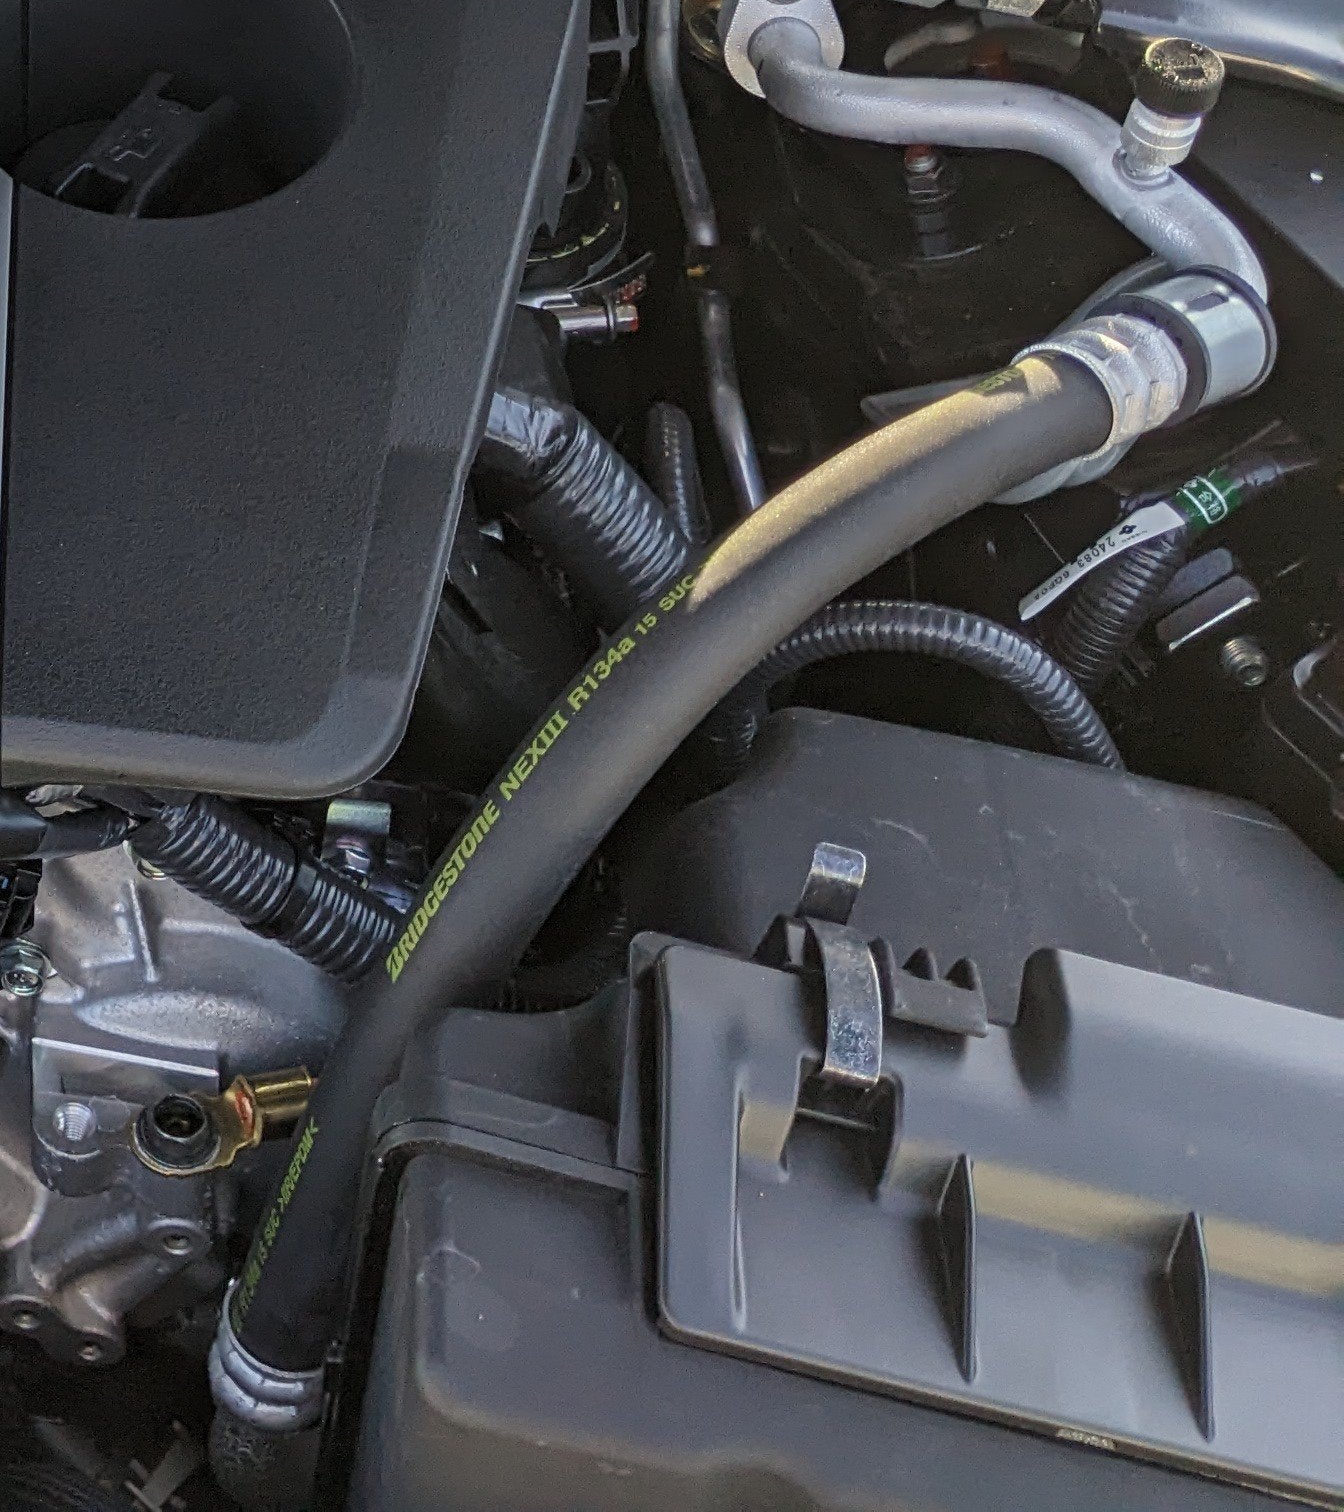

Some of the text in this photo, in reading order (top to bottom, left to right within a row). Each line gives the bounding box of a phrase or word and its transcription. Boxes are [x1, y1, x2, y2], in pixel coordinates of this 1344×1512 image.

[385, 800, 501, 983] BRIDGESTONE
[567, 635, 637, 716] R134a
[634, 611, 658, 637] 15
[658, 574, 697, 614] SUC
